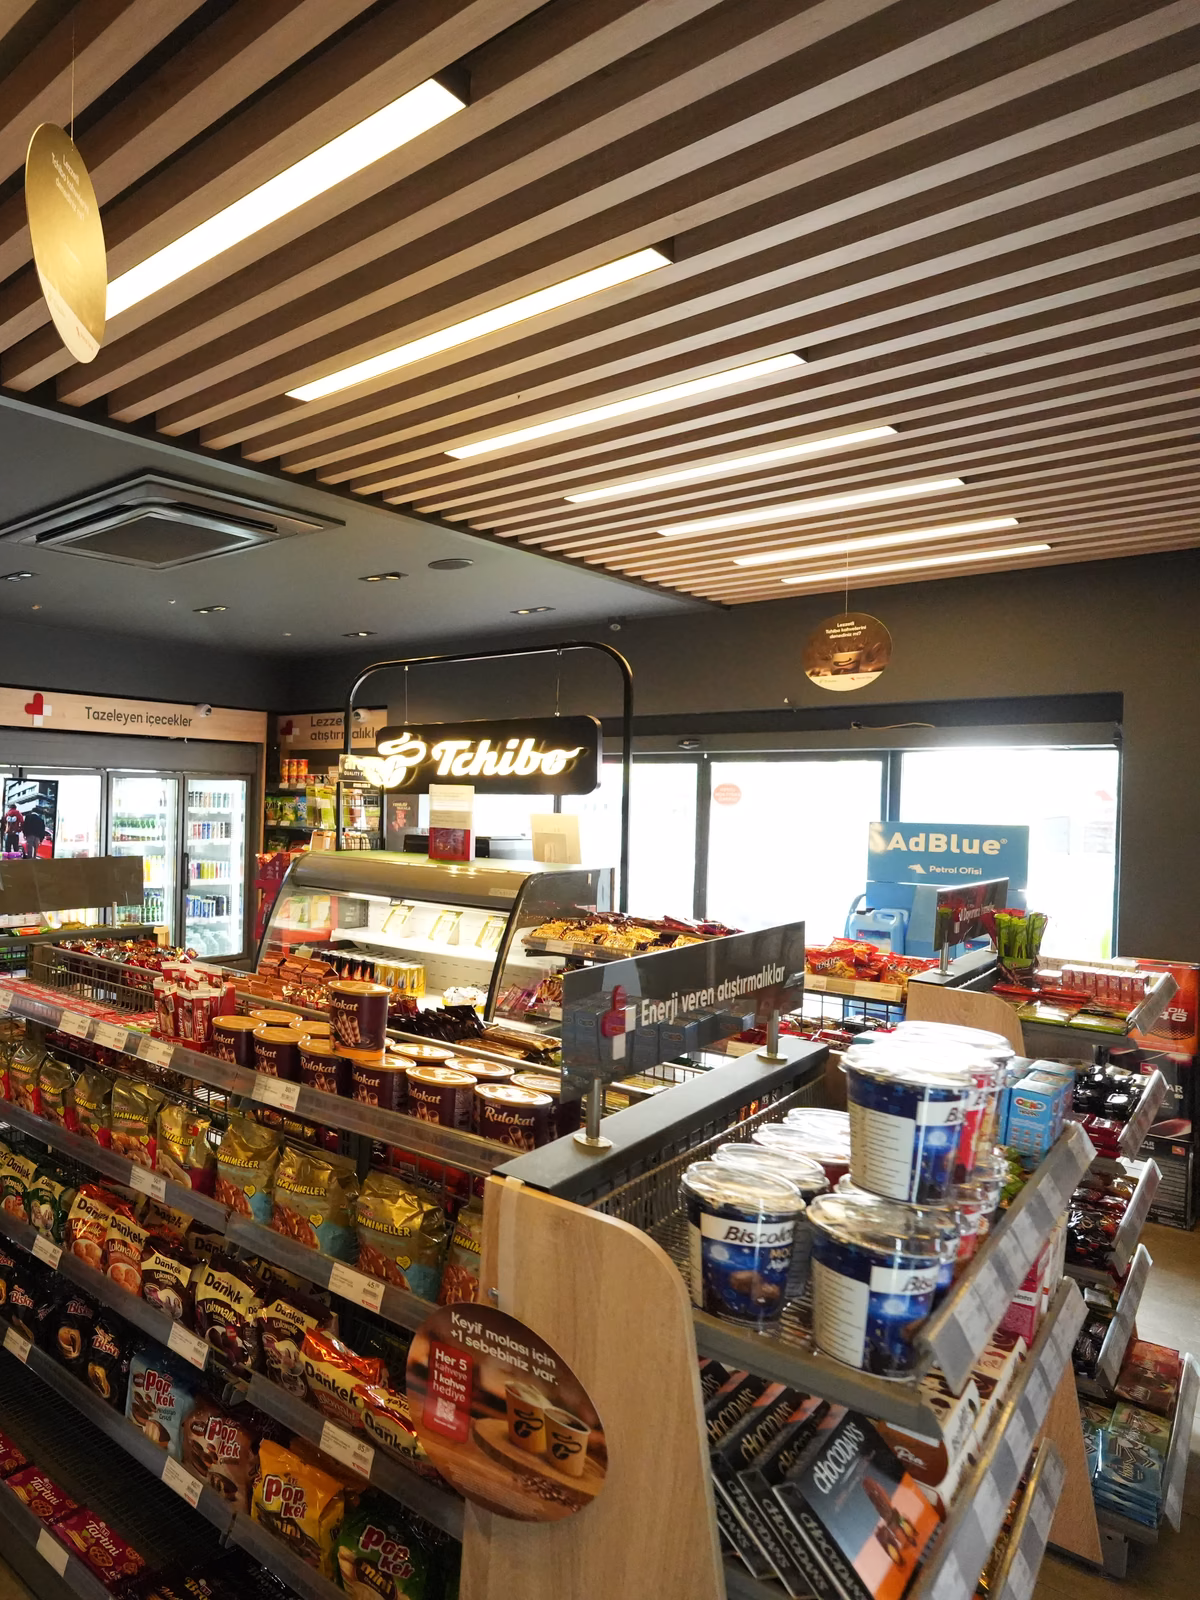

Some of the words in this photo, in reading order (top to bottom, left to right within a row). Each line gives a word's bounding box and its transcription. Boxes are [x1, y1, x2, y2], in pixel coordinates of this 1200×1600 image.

[85, 706, 143, 725] Tazeleyen
[145, 712, 193, 727] içecekler
[431, 737, 585, 776] Tchibo
[929, 865, 957, 874] Petrol
[960, 866, 983, 875] Ofisi
[641, 991, 679, 1027] Enerji
[681, 986, 714, 1013] veren
[717, 963, 786, 1003] atıştırmalıklar
[300, 1056, 336, 1075] Rulokat
[484, 1105, 536, 1127] Rulokat
[357, 1213, 412, 1238] HANIMELLER
[451, 1311, 484, 1336] Keyif
[485, 1329, 529, 1358] molası
[532, 1347, 557, 1370] için
[434, 1361, 468, 1382] kahveye
[435, 1348, 457, 1366] Her
[459, 1358, 468, 1371] 5
[451, 1329, 463, 1343] +1
[465, 1335, 529, 1372] sebebiniz
[532, 1365, 559, 1386] var.
[305, 1360, 360, 1407] Dankek
[432, 1382, 466, 1403] hediye
[433, 1370, 438, 1380] 1
[438, 1373, 466, 1392] kahve
[155, 1392, 176, 1409] kek
[205, 1416, 238, 1443] Pop
[741, 1400, 796, 1462] CHOCODANS
[219, 1441, 241, 1459] kek
[813, 1420, 866, 1495] CHOCODANS
[30, 1476, 63, 1506] Tartini
[263, 1473, 305, 1505] Pop
[281, 1500, 308, 1520] kek
[86, 1519, 123, 1558] Tartini
[726, 1479, 791, 1570] CHOCODANS
[359, 1524, 410, 1562] Pop
[761, 1498, 828, 1591] CHOCODANS
[360, 1561, 393, 1594] mini
[377, 1555, 415, 1580] kek
